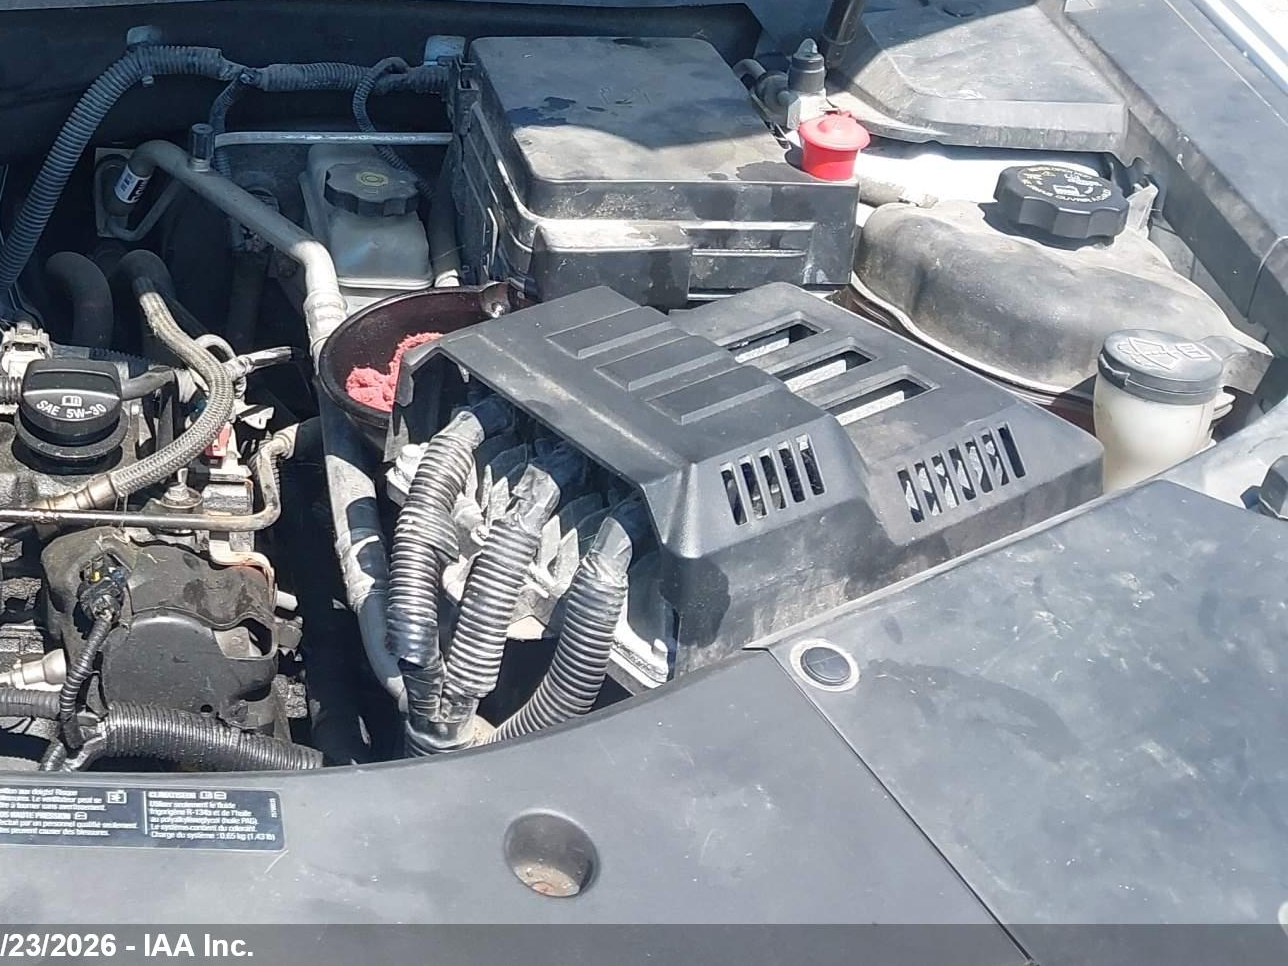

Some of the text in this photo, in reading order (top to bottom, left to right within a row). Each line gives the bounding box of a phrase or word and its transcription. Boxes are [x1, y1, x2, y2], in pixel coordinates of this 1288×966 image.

[36, 400, 107, 419] SAE 5W-30
[151, 831, 175, 839] Charge
[236, 833, 247, 841] kg
